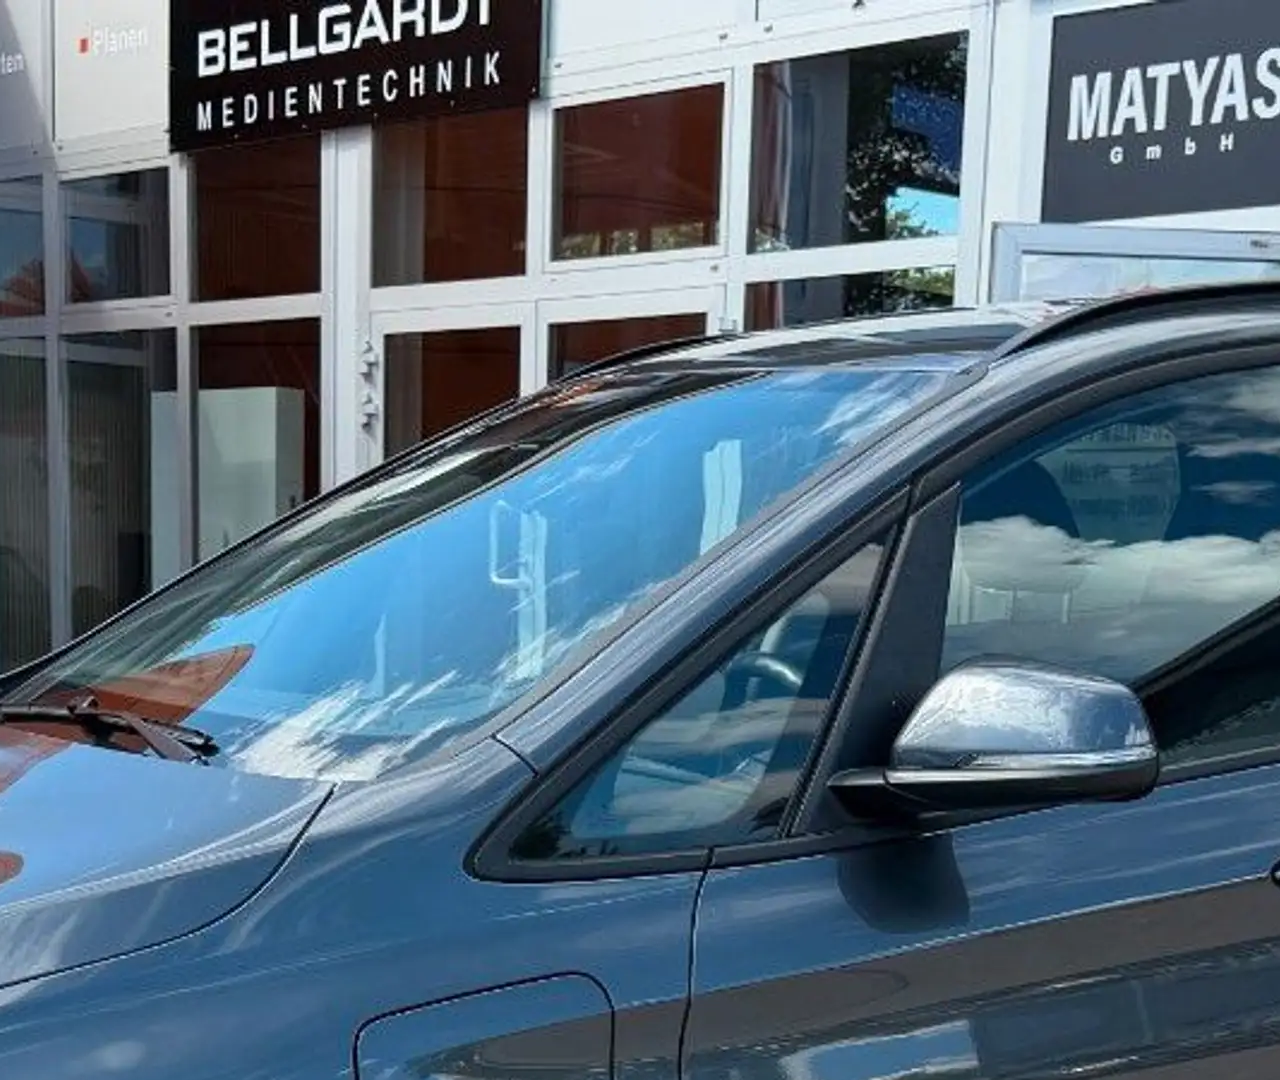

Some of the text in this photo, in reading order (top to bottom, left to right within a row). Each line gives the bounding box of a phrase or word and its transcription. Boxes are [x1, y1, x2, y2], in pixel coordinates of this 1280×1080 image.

[92, 25, 148, 54] Planen
[197, 51, 500, 131] MEDIENTECHNIK
[1110, 132, 1234, 164] GmbH
